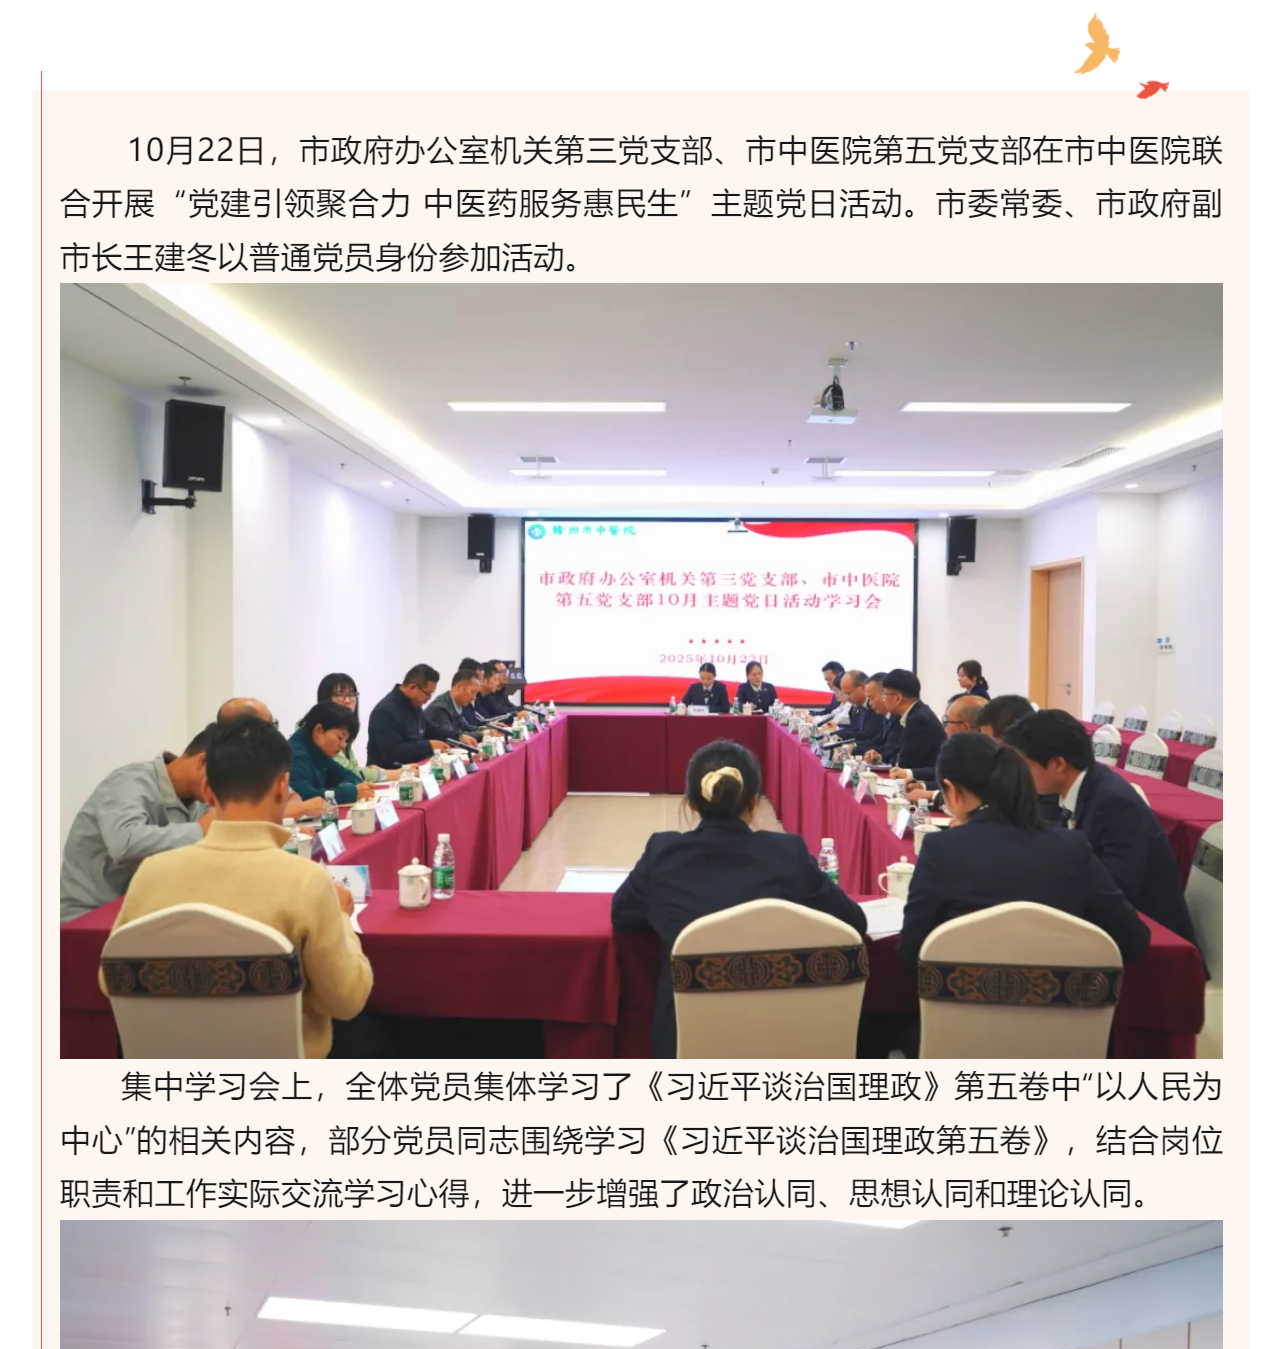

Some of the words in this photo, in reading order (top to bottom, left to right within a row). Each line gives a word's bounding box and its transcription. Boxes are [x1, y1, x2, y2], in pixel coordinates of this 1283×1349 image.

[539, 570, 901, 587] 市政府办公室机关第三党支部、市中医院
[556, 592, 882, 609] 第五党支部10月主题党日活动学习会
